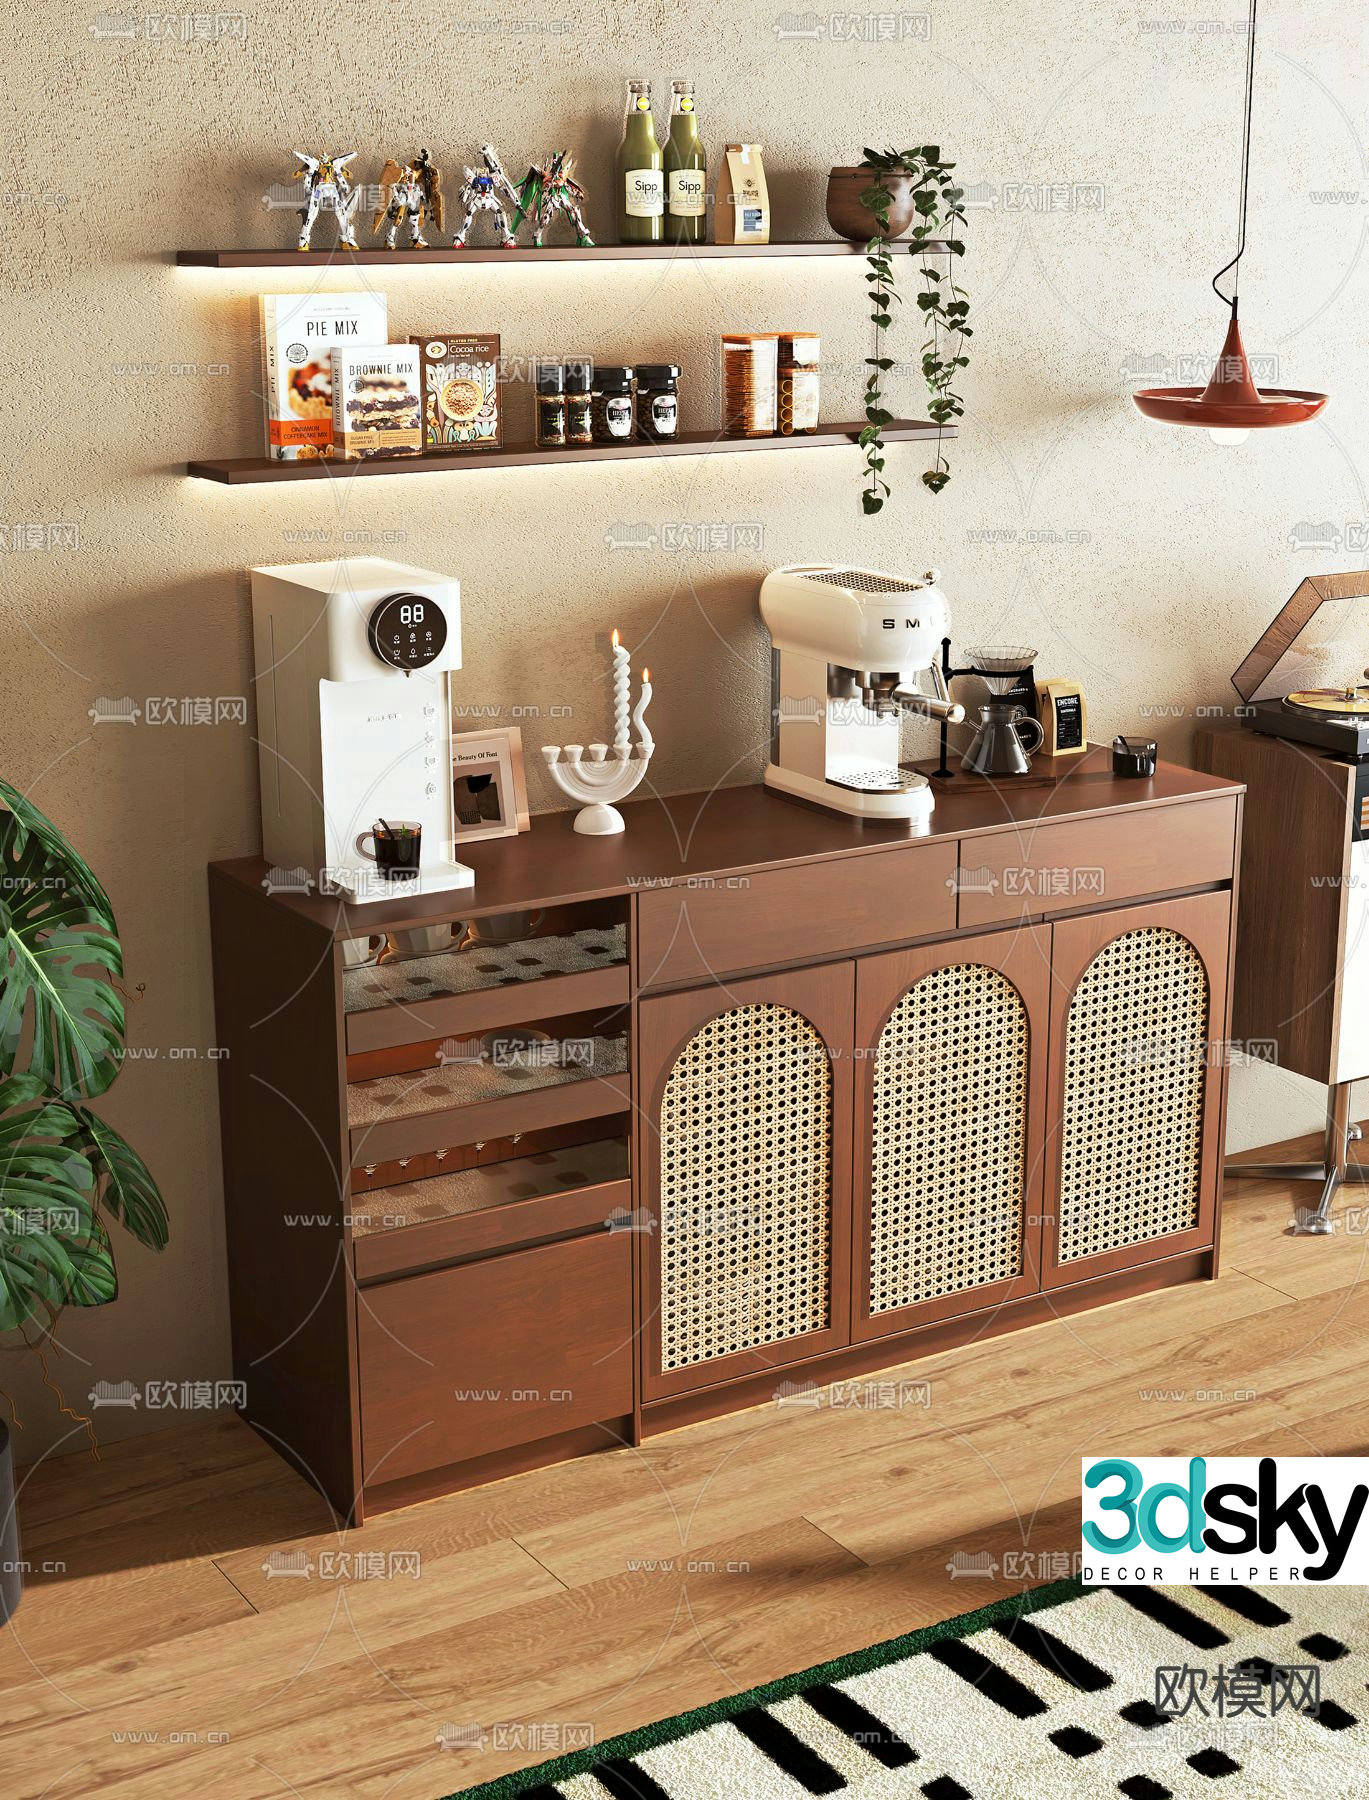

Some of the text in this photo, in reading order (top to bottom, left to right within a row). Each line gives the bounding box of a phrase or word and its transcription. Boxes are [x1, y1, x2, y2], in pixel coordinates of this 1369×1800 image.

[635, 180, 657, 194] Sipp
[678, 180, 701, 194] Sipp
[307, 320, 358, 336] PIE MIX
[450, 344, 490, 353] Cocoa rice
[349, 363, 413, 376] BROWNIE MIX
[400, 603, 424, 625] 88
[1057, 696, 1079, 707] ENCORE
[477, 751, 485, 759] Of
